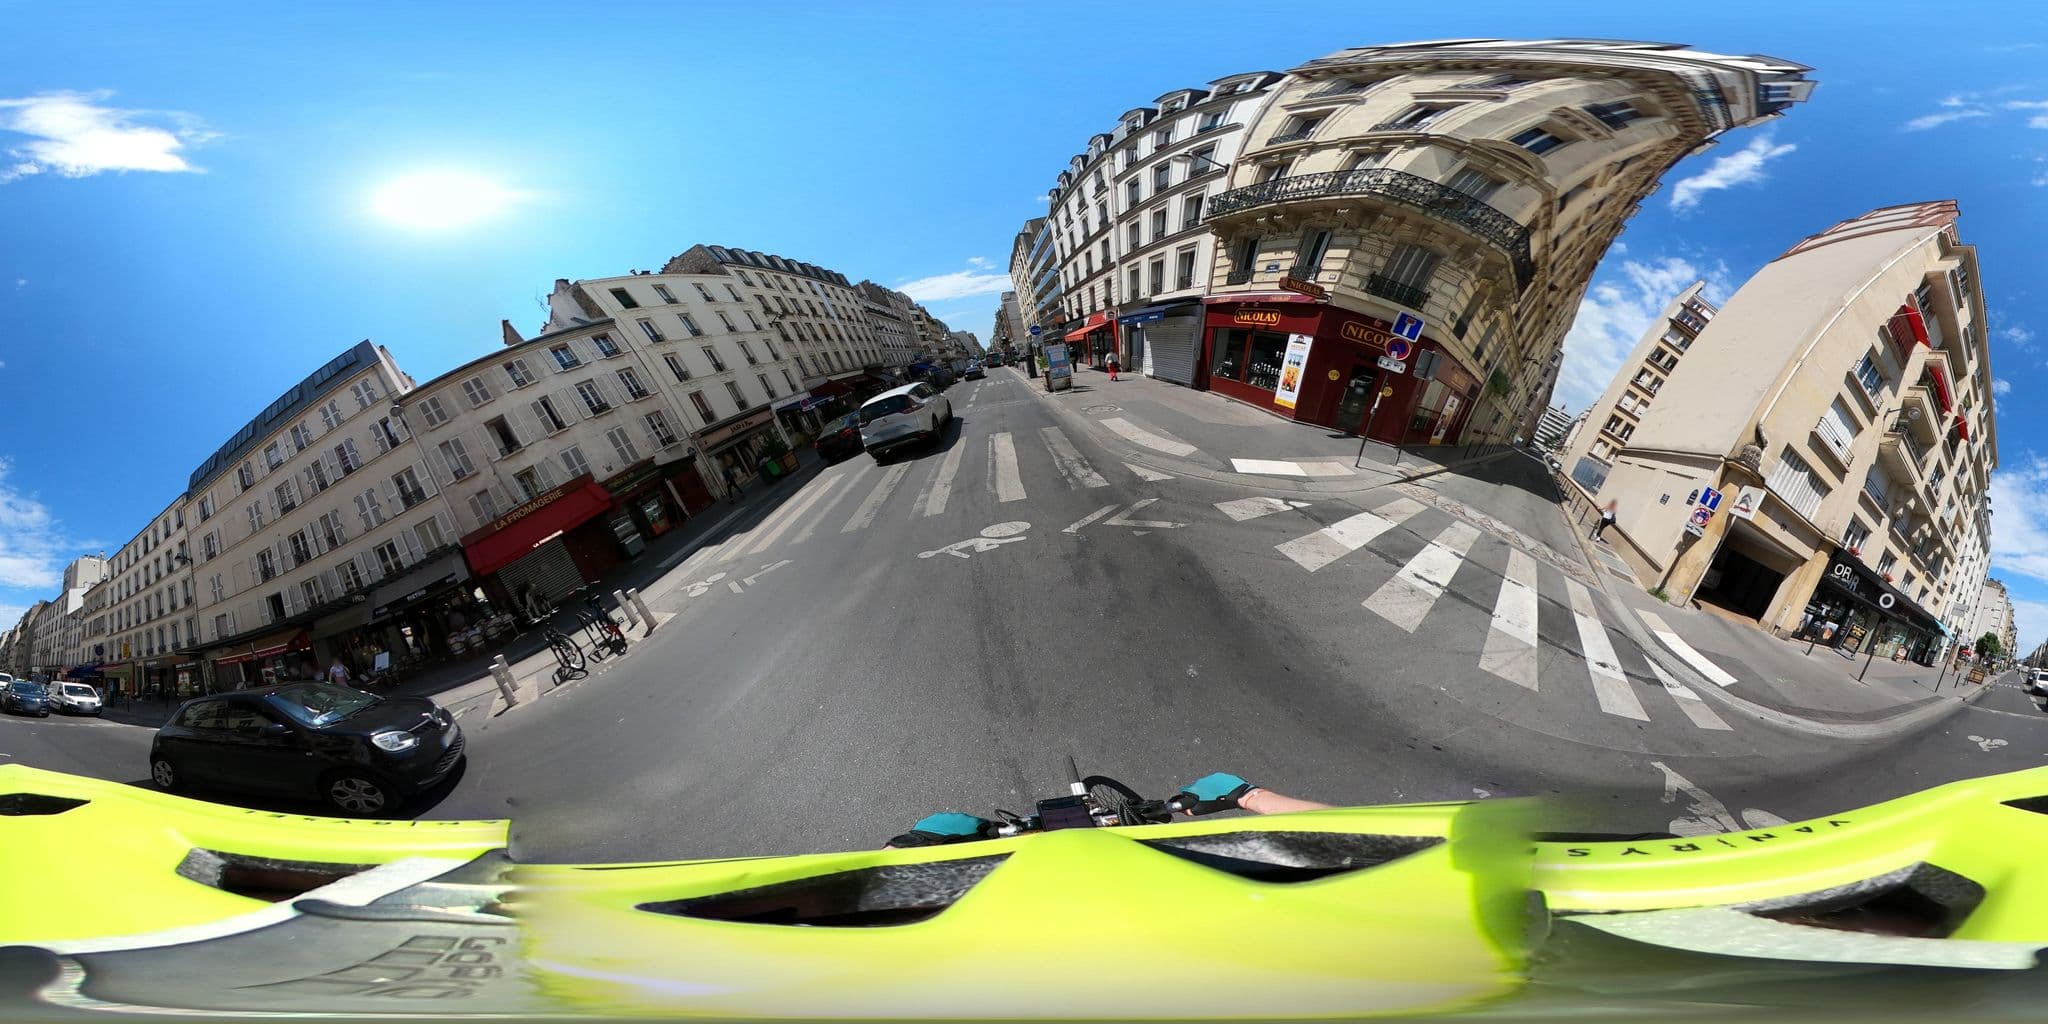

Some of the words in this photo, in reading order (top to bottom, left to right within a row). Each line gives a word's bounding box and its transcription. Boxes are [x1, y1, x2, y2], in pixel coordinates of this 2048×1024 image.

[1289, 281, 1321, 295] NICOLAS
[1237, 311, 1278, 322] NICOLAS
[1346, 325, 1390, 346] NICO
[494, 519, 508, 530] LA
[508, 488, 565, 523] FROMAGERIE
